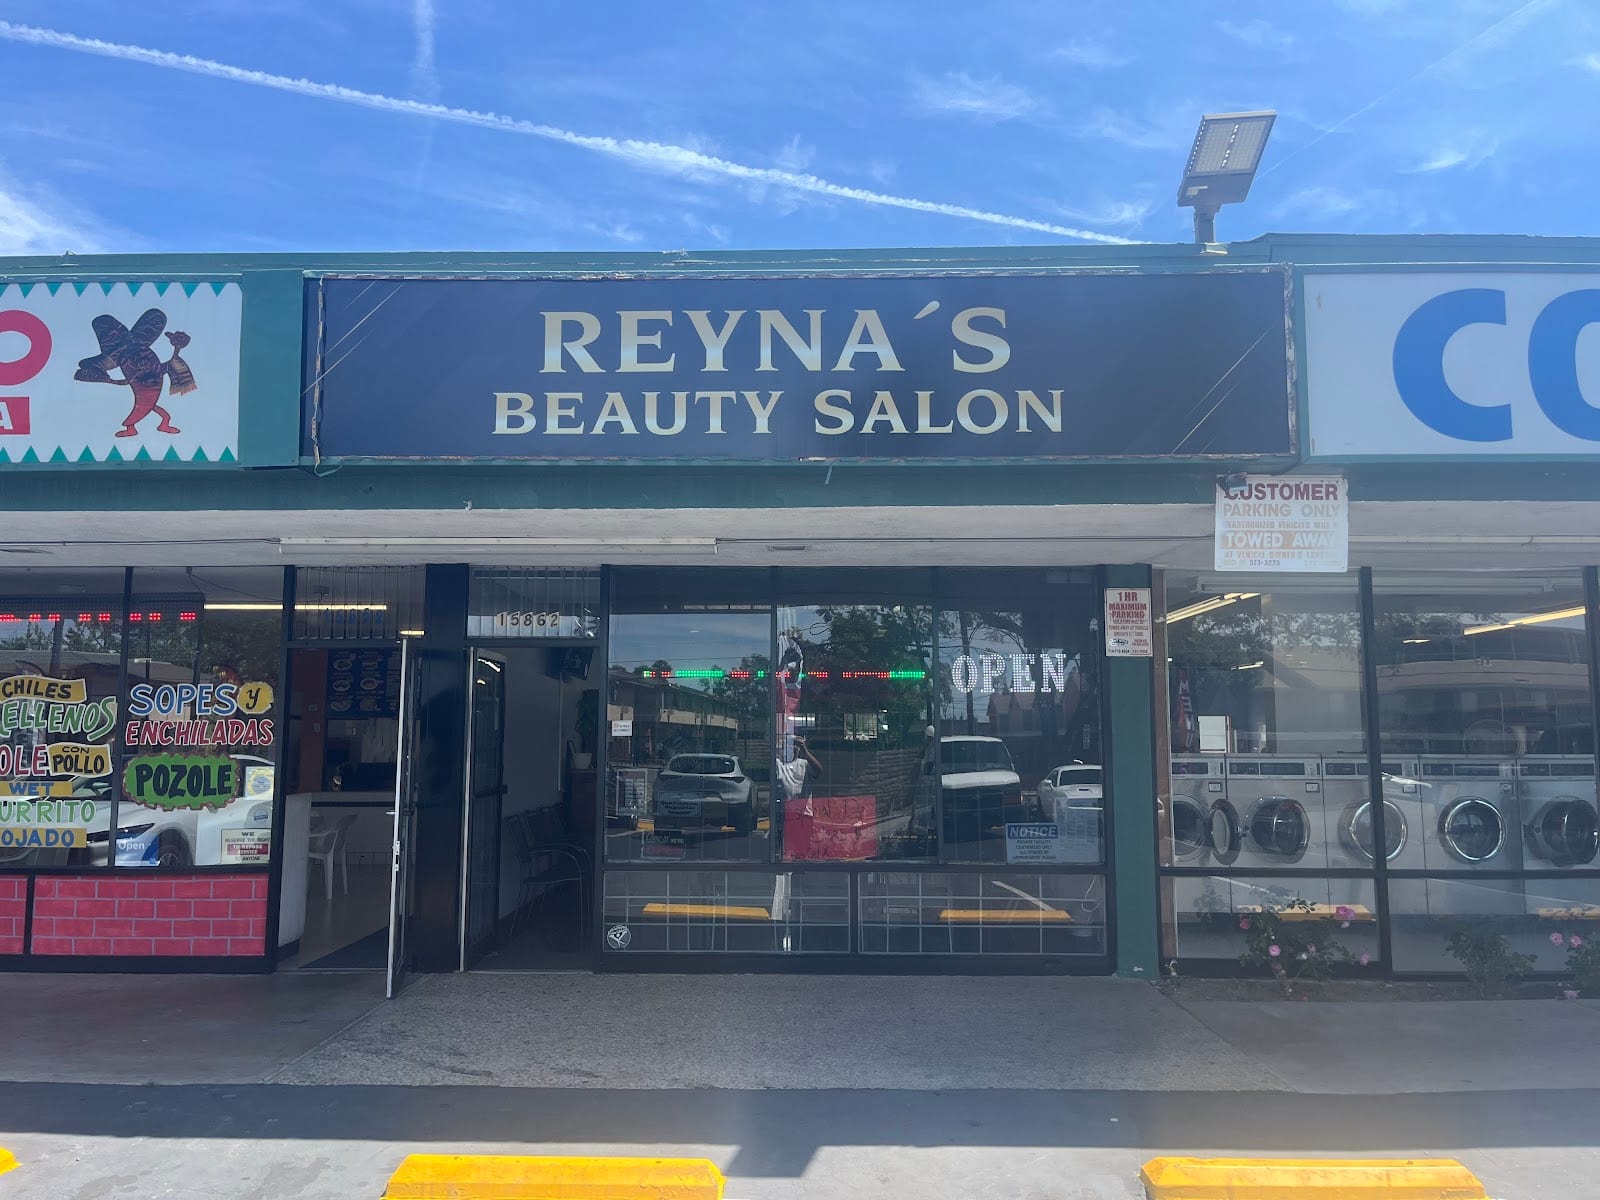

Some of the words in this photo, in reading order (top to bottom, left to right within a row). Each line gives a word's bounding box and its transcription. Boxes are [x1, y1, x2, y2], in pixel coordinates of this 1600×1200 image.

[491, 390, 785, 435] BEAUTY
[813, 388, 1065, 435] SALON
[1223, 503, 1292, 517] PARKING
[1301, 503, 1340, 518] ONLY
[1225, 532, 1283, 548] TOWED
[1117, 592, 1123, 601] 1
[1125, 592, 1138, 601] HR
[1109, 603, 1147, 611] MAXIMUM
[1112, 611, 1145, 619] PARKING
[500, 613, 558, 627] 15862
[951, 653, 1067, 693] OPEN
[2, 679, 72, 700] CHILES
[128, 683, 239, 716] SOPES
[0, 696, 117, 742] ELLENOS
[125, 719, 274, 746] ENCHILADAS
[62, 746, 90, 754] CON
[52, 754, 105, 774] POLLO
[9, 782, 54, 795] WET
[135, 764, 232, 799] POZOLE
[1, 828, 75, 848] OJADO
[1010, 826, 1057, 838] NOTICE
[118, 841, 145, 852] Open
